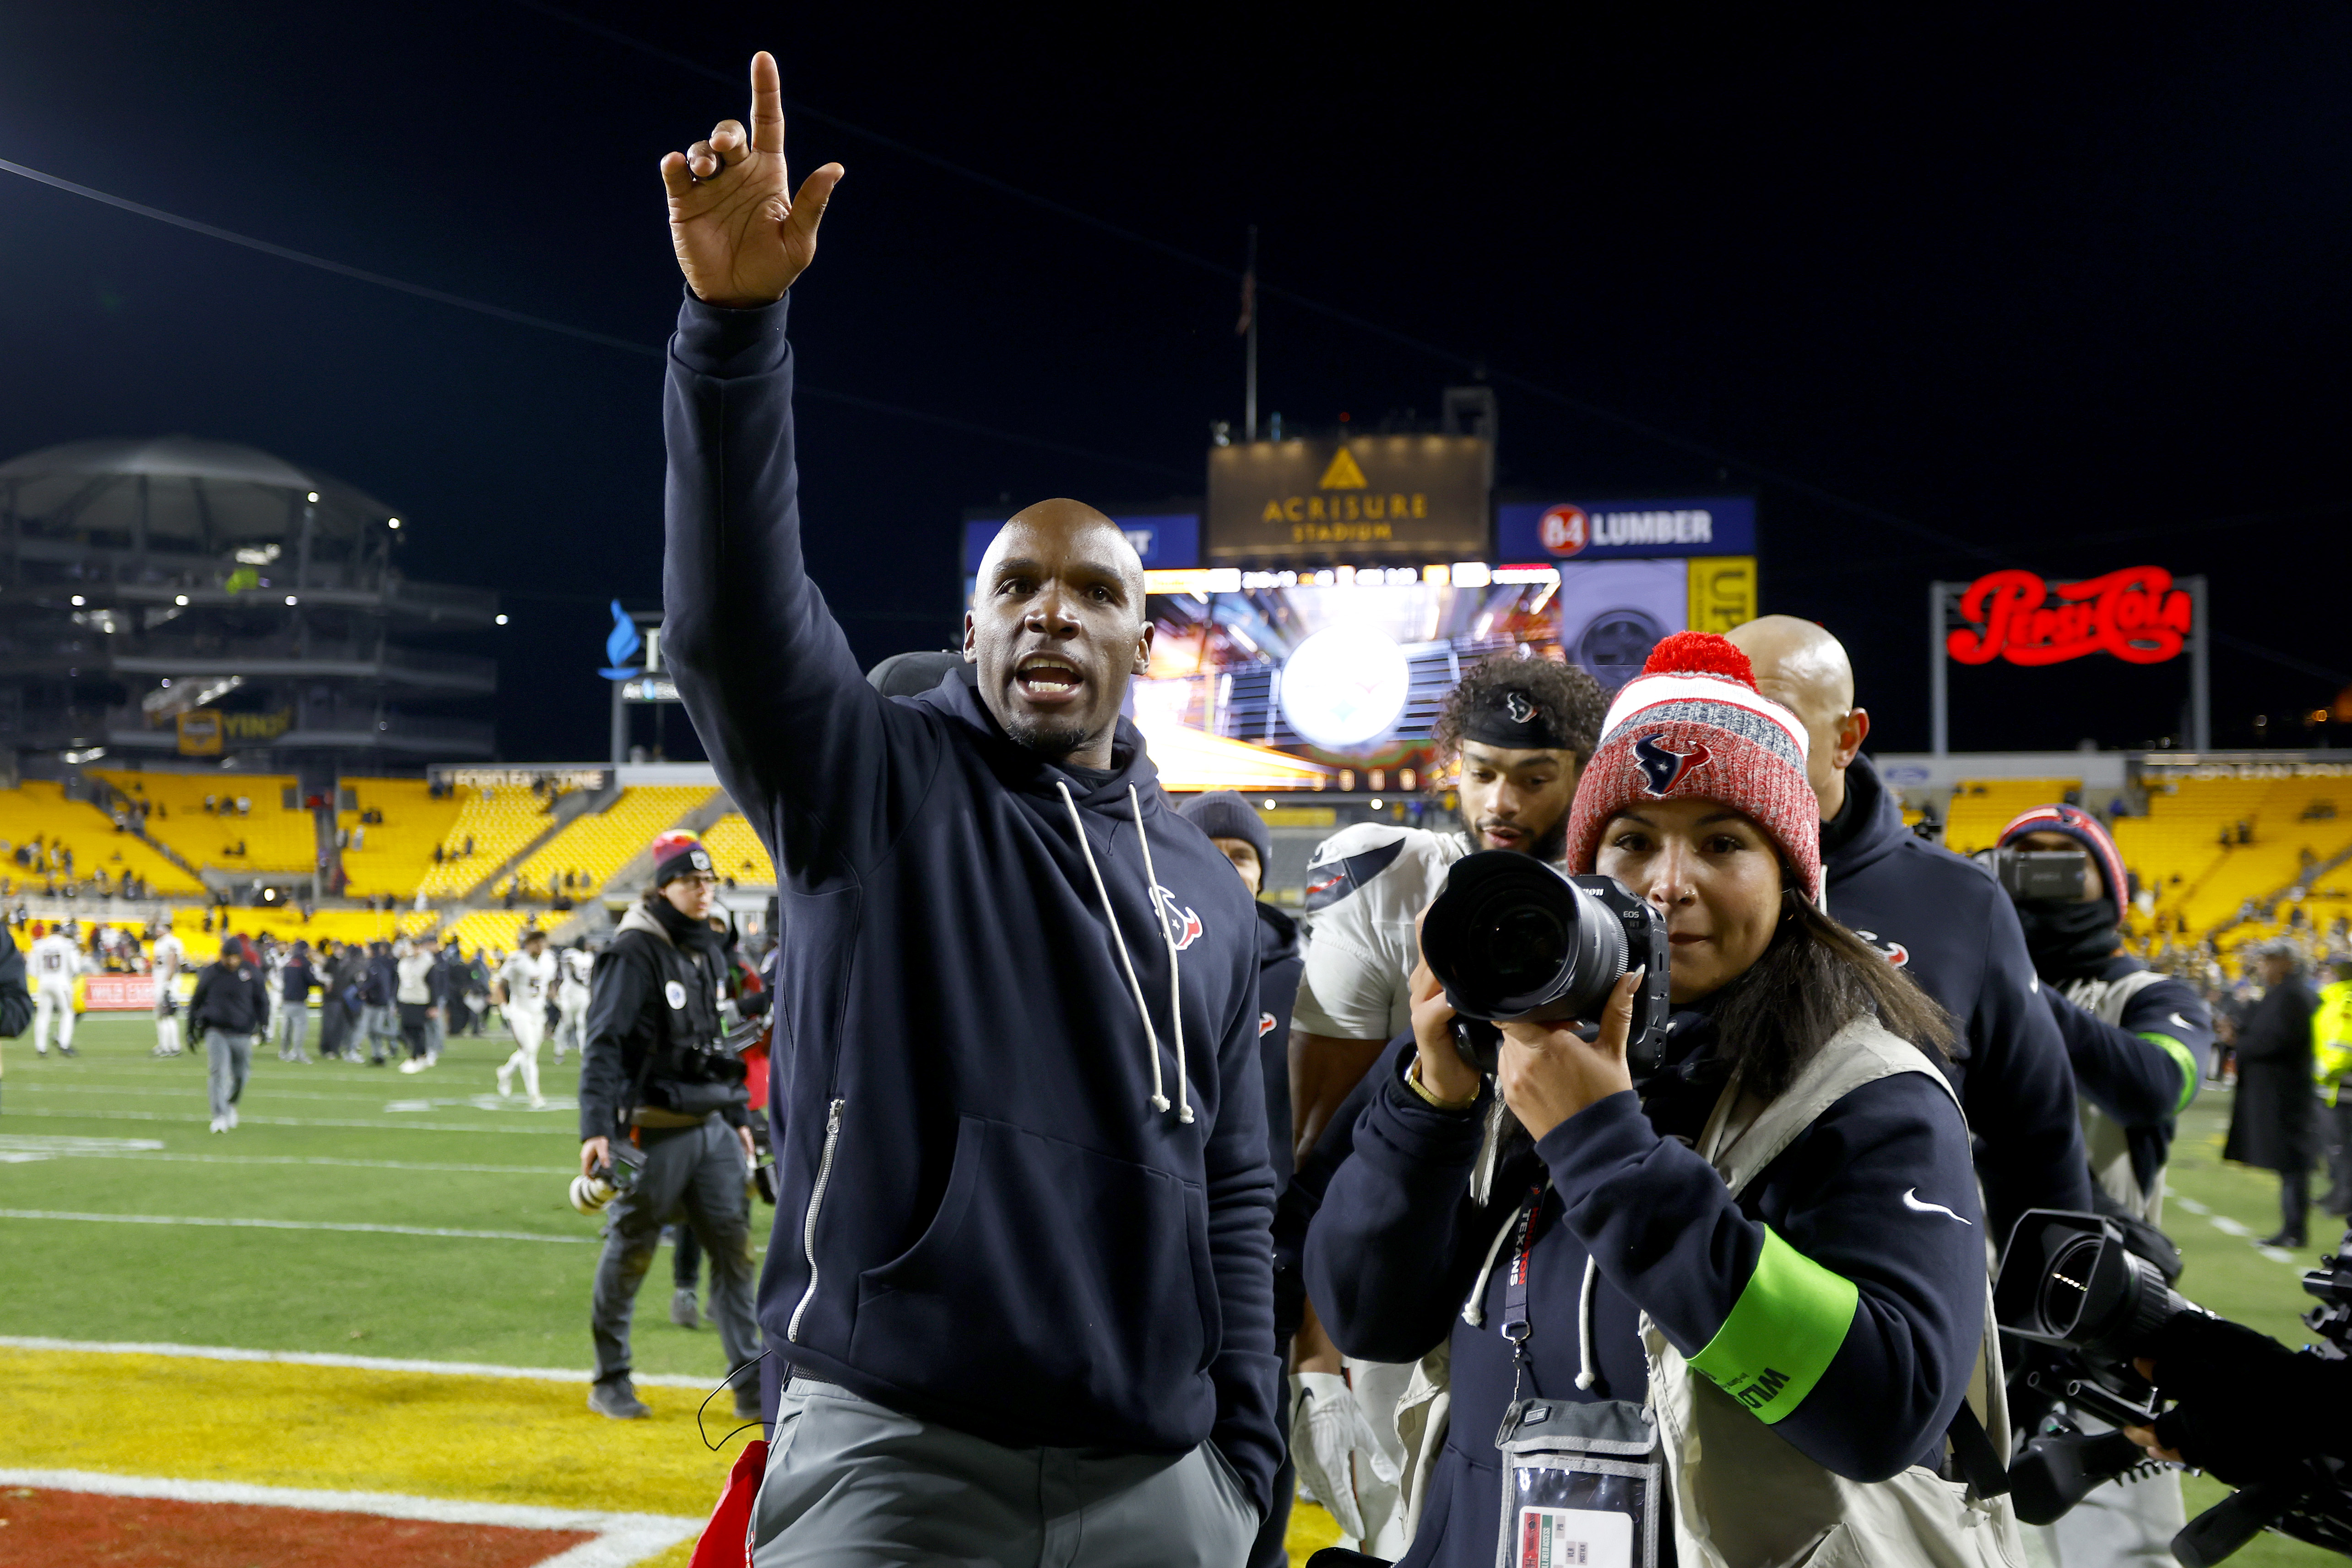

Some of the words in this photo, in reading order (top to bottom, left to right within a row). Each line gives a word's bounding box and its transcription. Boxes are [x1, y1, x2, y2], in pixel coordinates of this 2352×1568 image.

[1263, 493, 1428, 522] ACRISURE
[1292, 522, 1393, 543] STADIUM
[1543, 514, 1585, 547] 84
[1591, 509, 1713, 546] LUMBER
[1710, 570, 1746, 632] UP
[1510, 1209, 1531, 1287] TEXANS
[1518, 1207, 1539, 1285] HOUSTON
[1738, 1368, 1790, 1408] WILD
